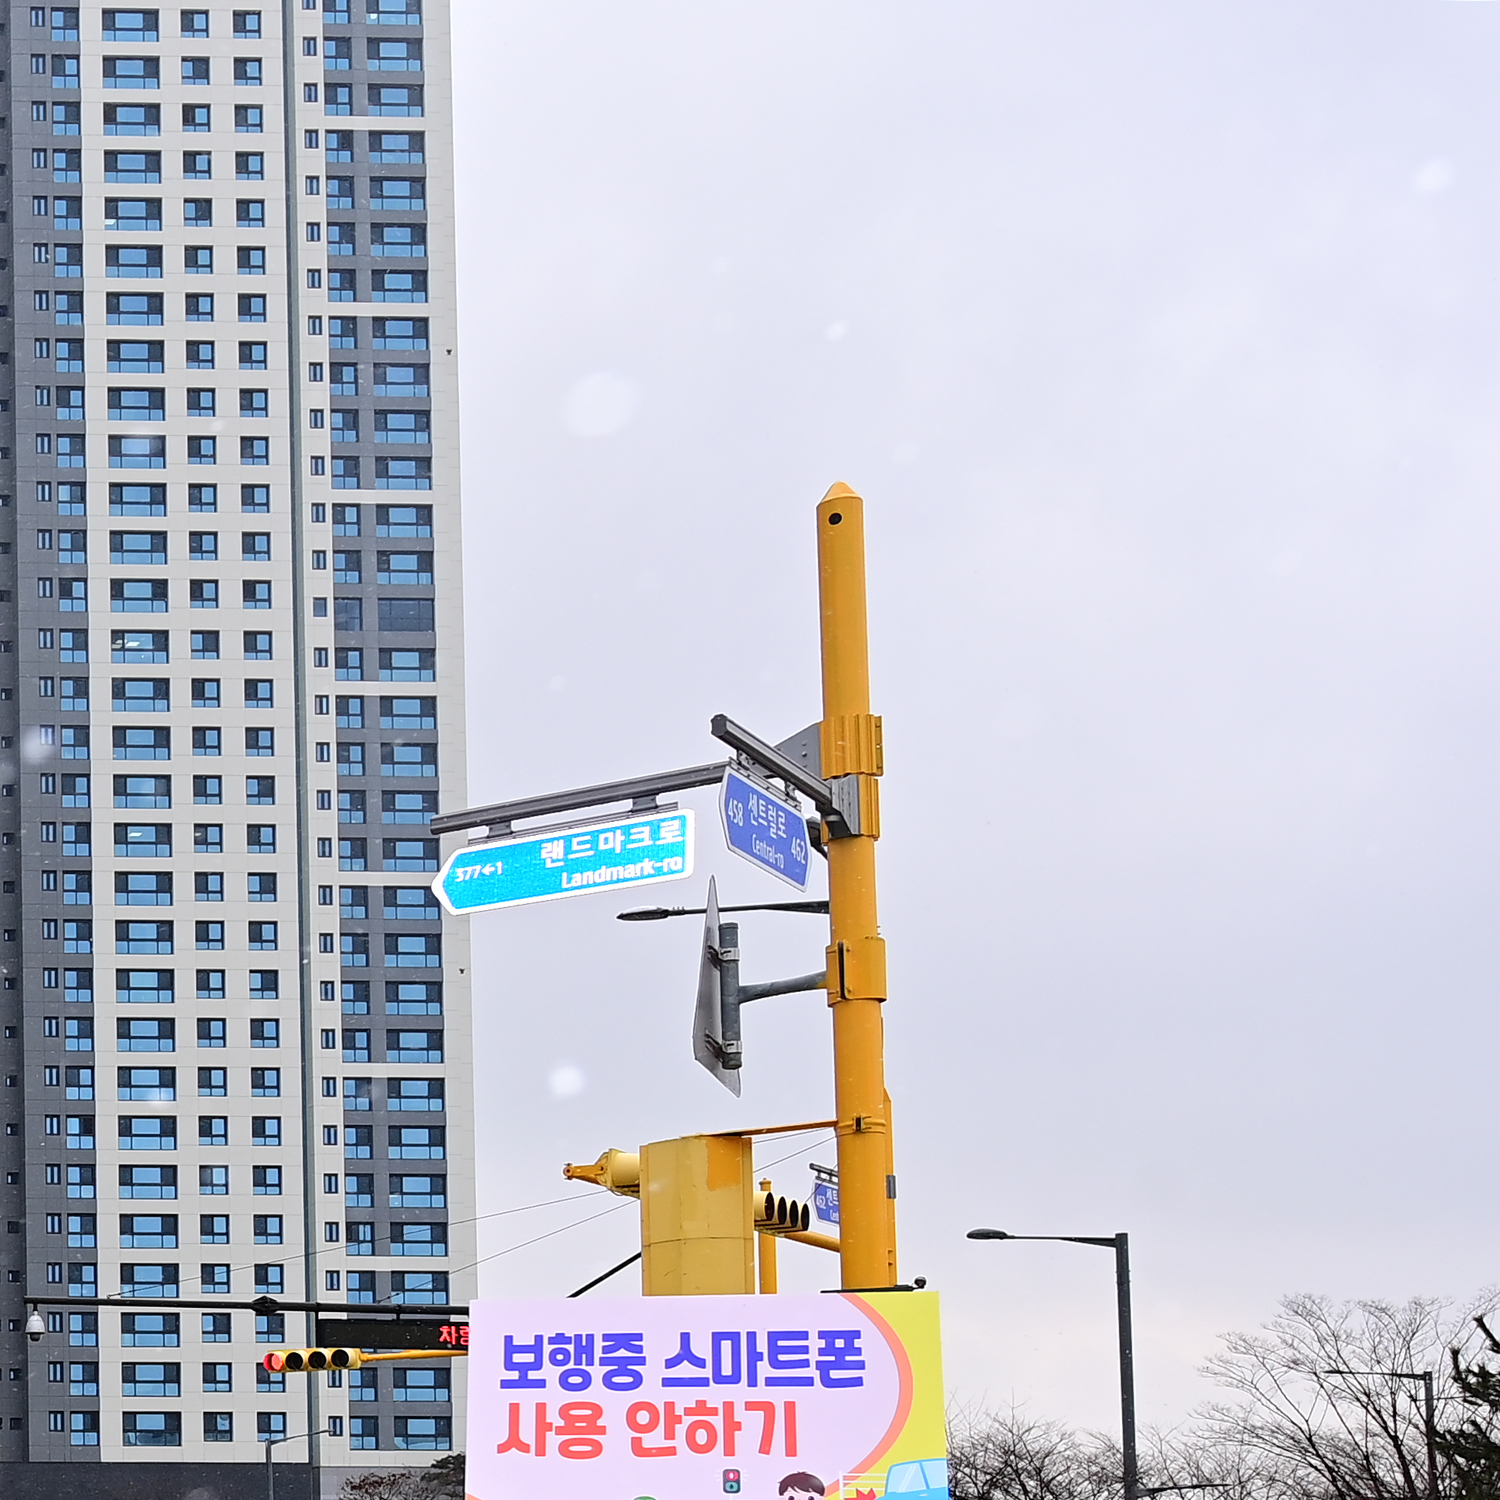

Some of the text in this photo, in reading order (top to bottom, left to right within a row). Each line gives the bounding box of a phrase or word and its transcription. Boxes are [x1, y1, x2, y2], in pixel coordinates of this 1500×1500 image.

[728, 797, 744, 827] 458
[748, 792, 787, 839] 센트럴로
[541, 819, 684, 868] 랜드마크로
[751, 833, 785, 869] Central-ro
[791, 836, 806, 864] 462
[562, 857, 683, 888] Landmark-ro
[499, 1329, 866, 1391] 보행중 스마트폰
[497, 1399, 797, 1459] 사용 안하기
